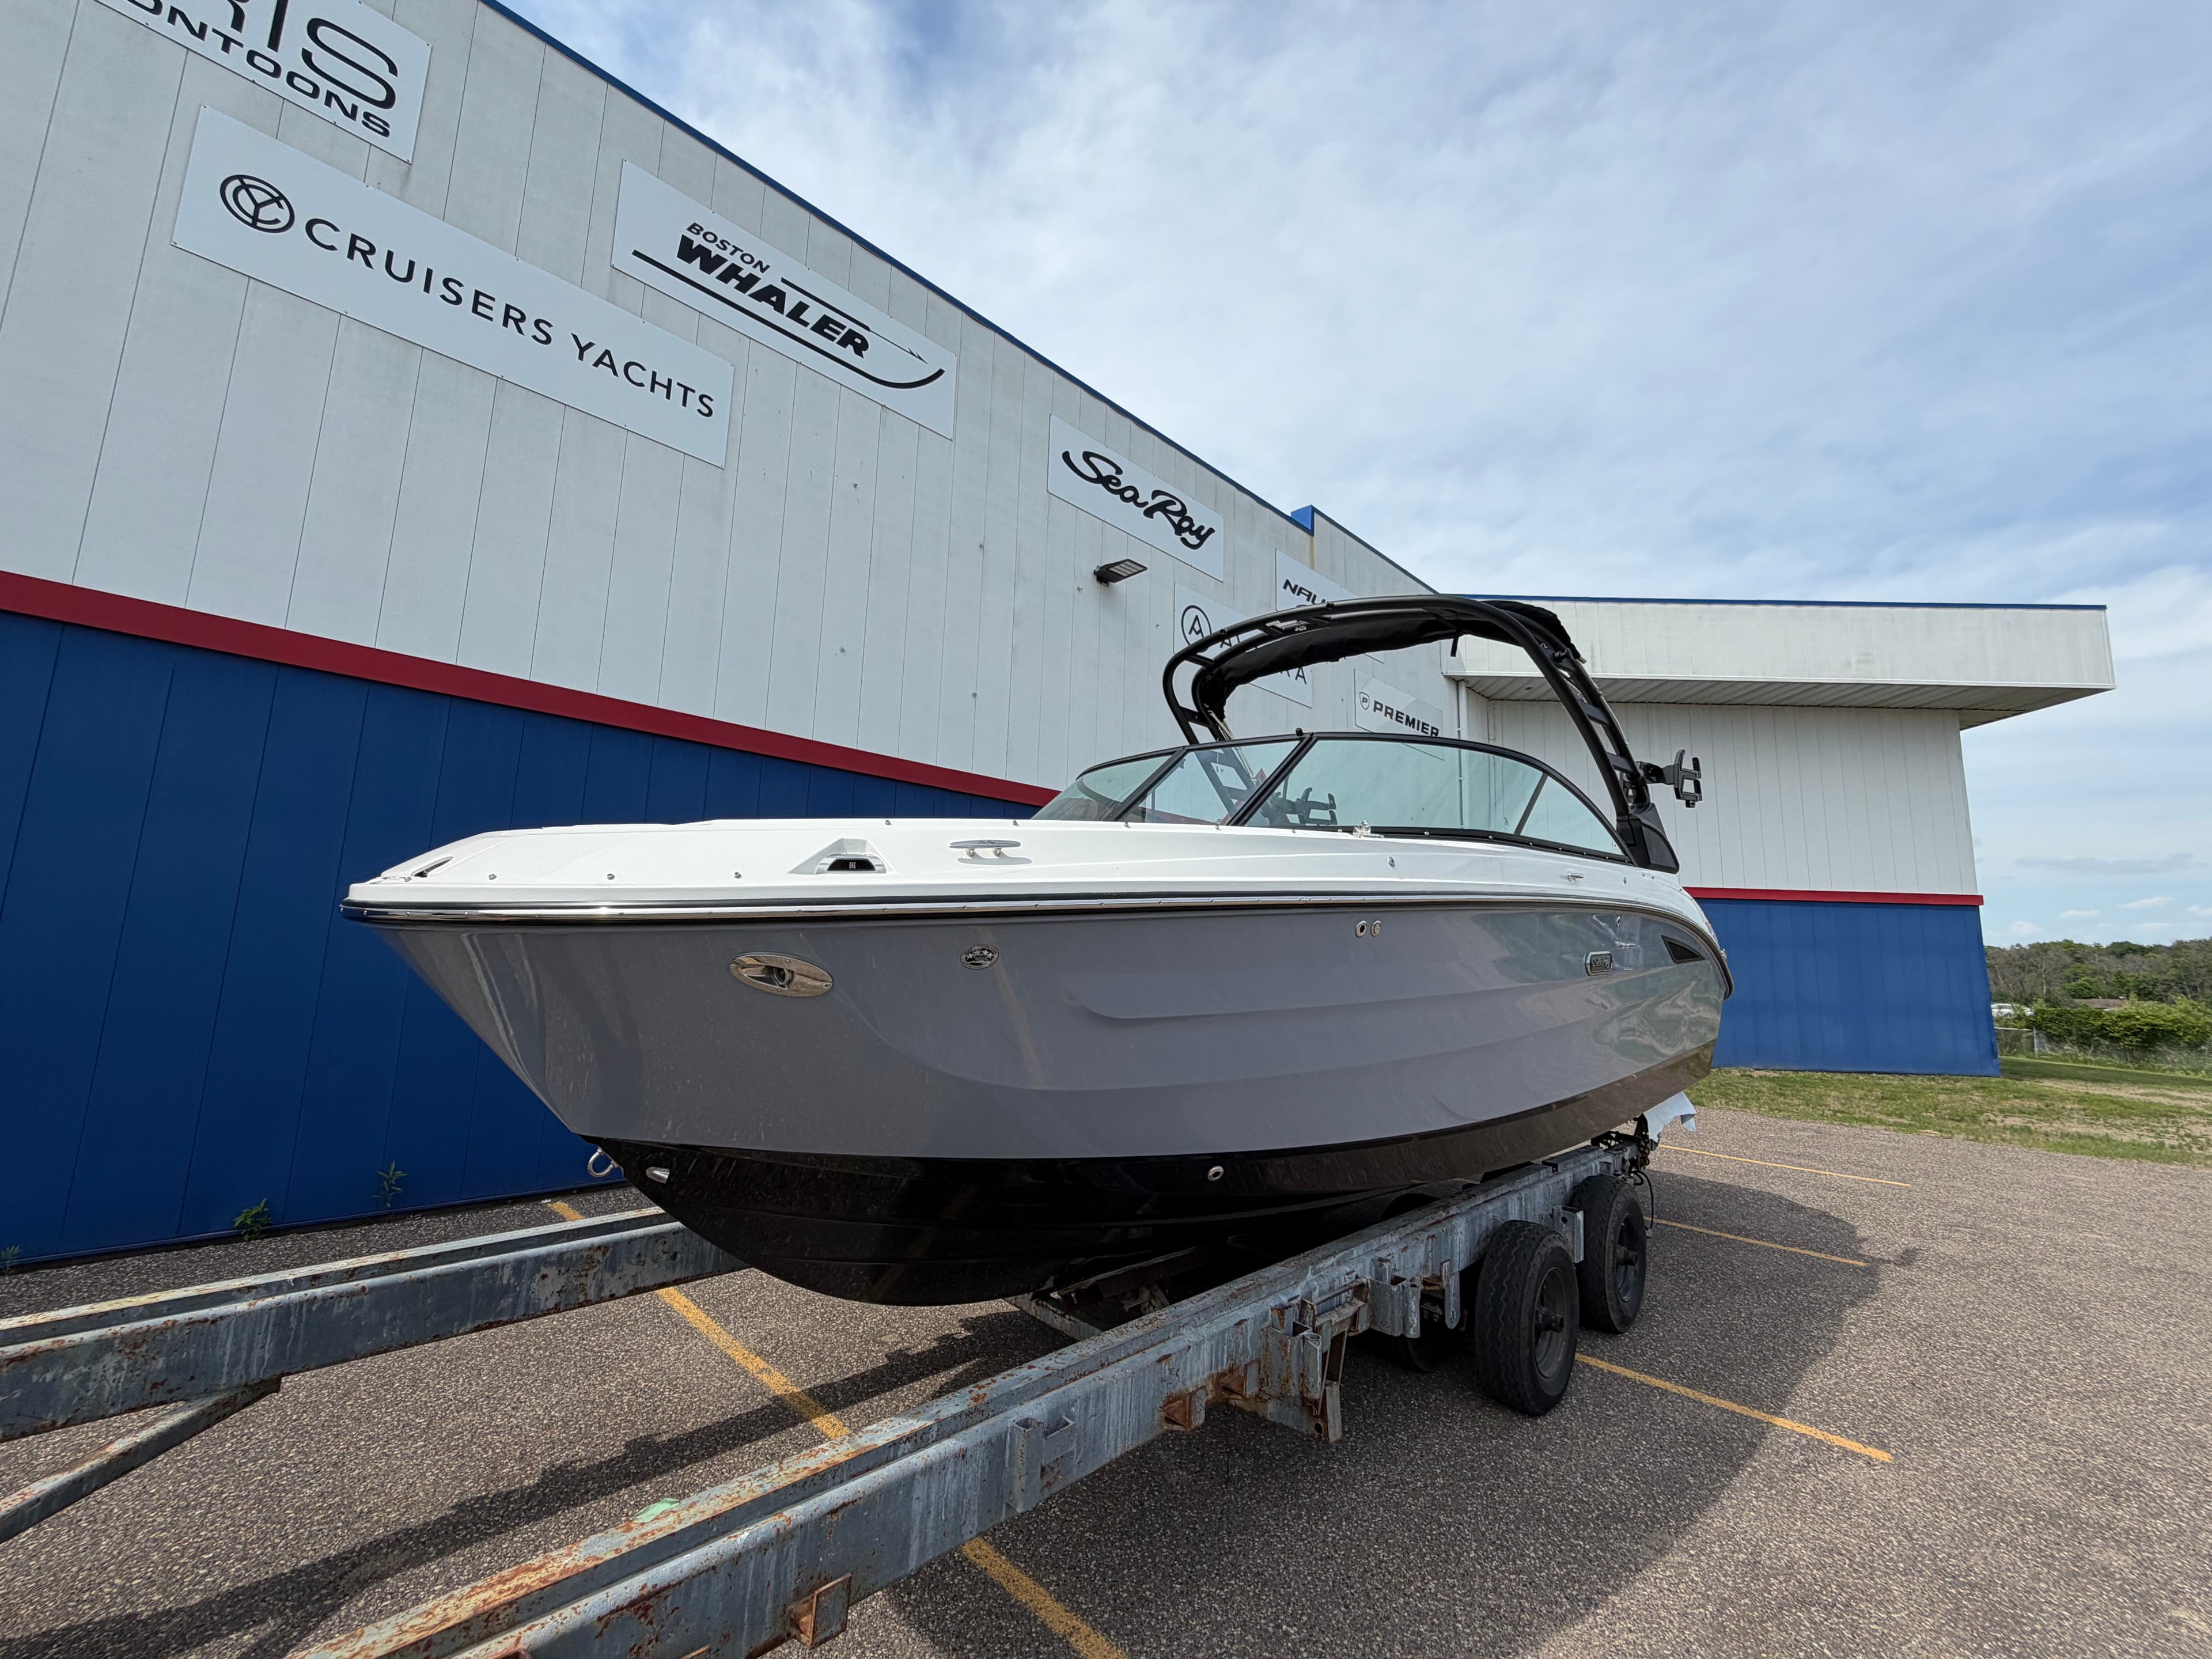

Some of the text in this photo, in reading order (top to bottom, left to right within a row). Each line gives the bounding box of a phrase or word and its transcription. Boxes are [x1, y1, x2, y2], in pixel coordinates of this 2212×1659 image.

[228, 0, 398, 109] IS
[676, 234, 869, 359] WHALER
[686, 222, 771, 274] BOSTON
[305, 218, 554, 345] CRUISERS
[571, 333, 714, 418] YACHTS
[1373, 699, 1440, 737] PREMIER
